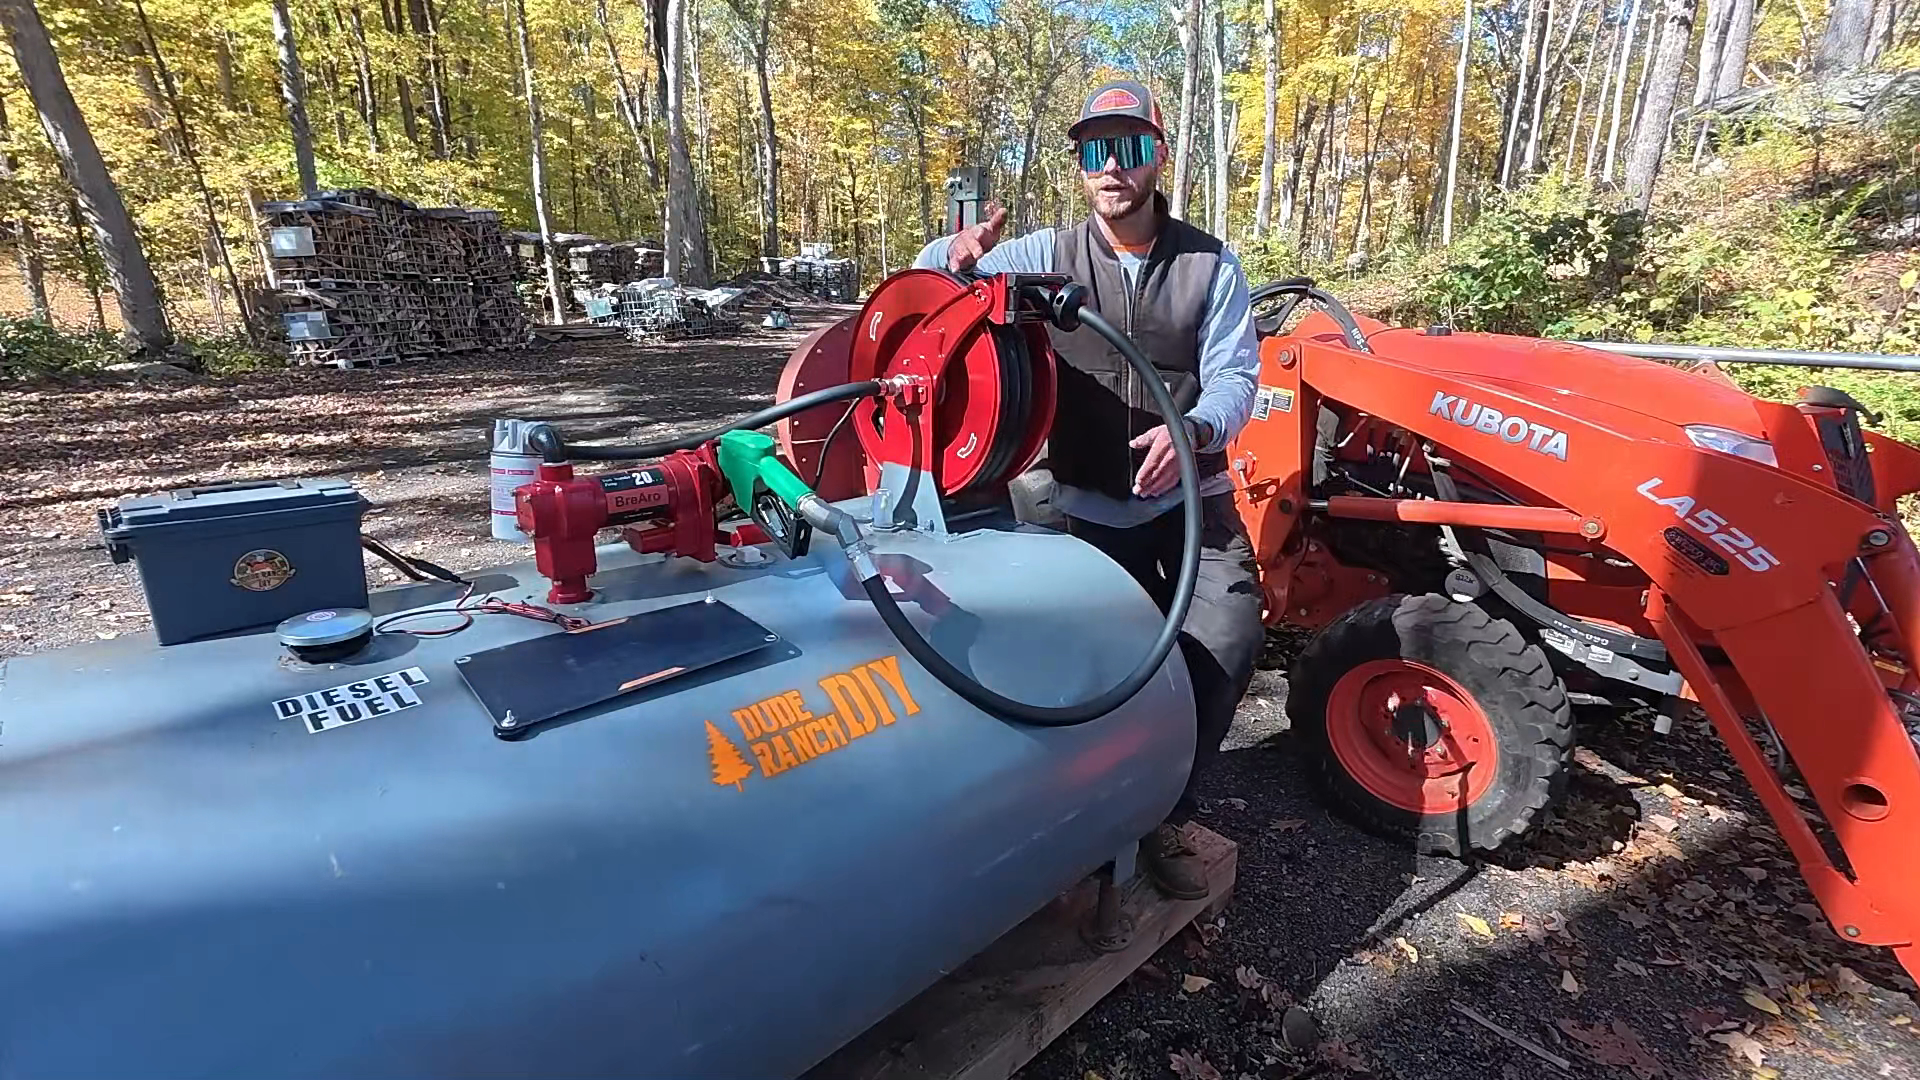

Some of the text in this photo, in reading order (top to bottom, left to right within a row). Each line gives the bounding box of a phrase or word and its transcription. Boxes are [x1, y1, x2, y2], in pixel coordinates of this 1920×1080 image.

[1428, 390, 1568, 462] KUBOTA
[615, 492, 661, 508] BreAro
[631, 471, 653, 486] 20
[1636, 477, 1780, 572] LA525
[277, 671, 425, 717] DIESEL
[308, 692, 418, 731] FUEL
[731, 689, 813, 741] DUDE
[818, 656, 920, 739] DIY
[750, 713, 849, 777] RANCH
